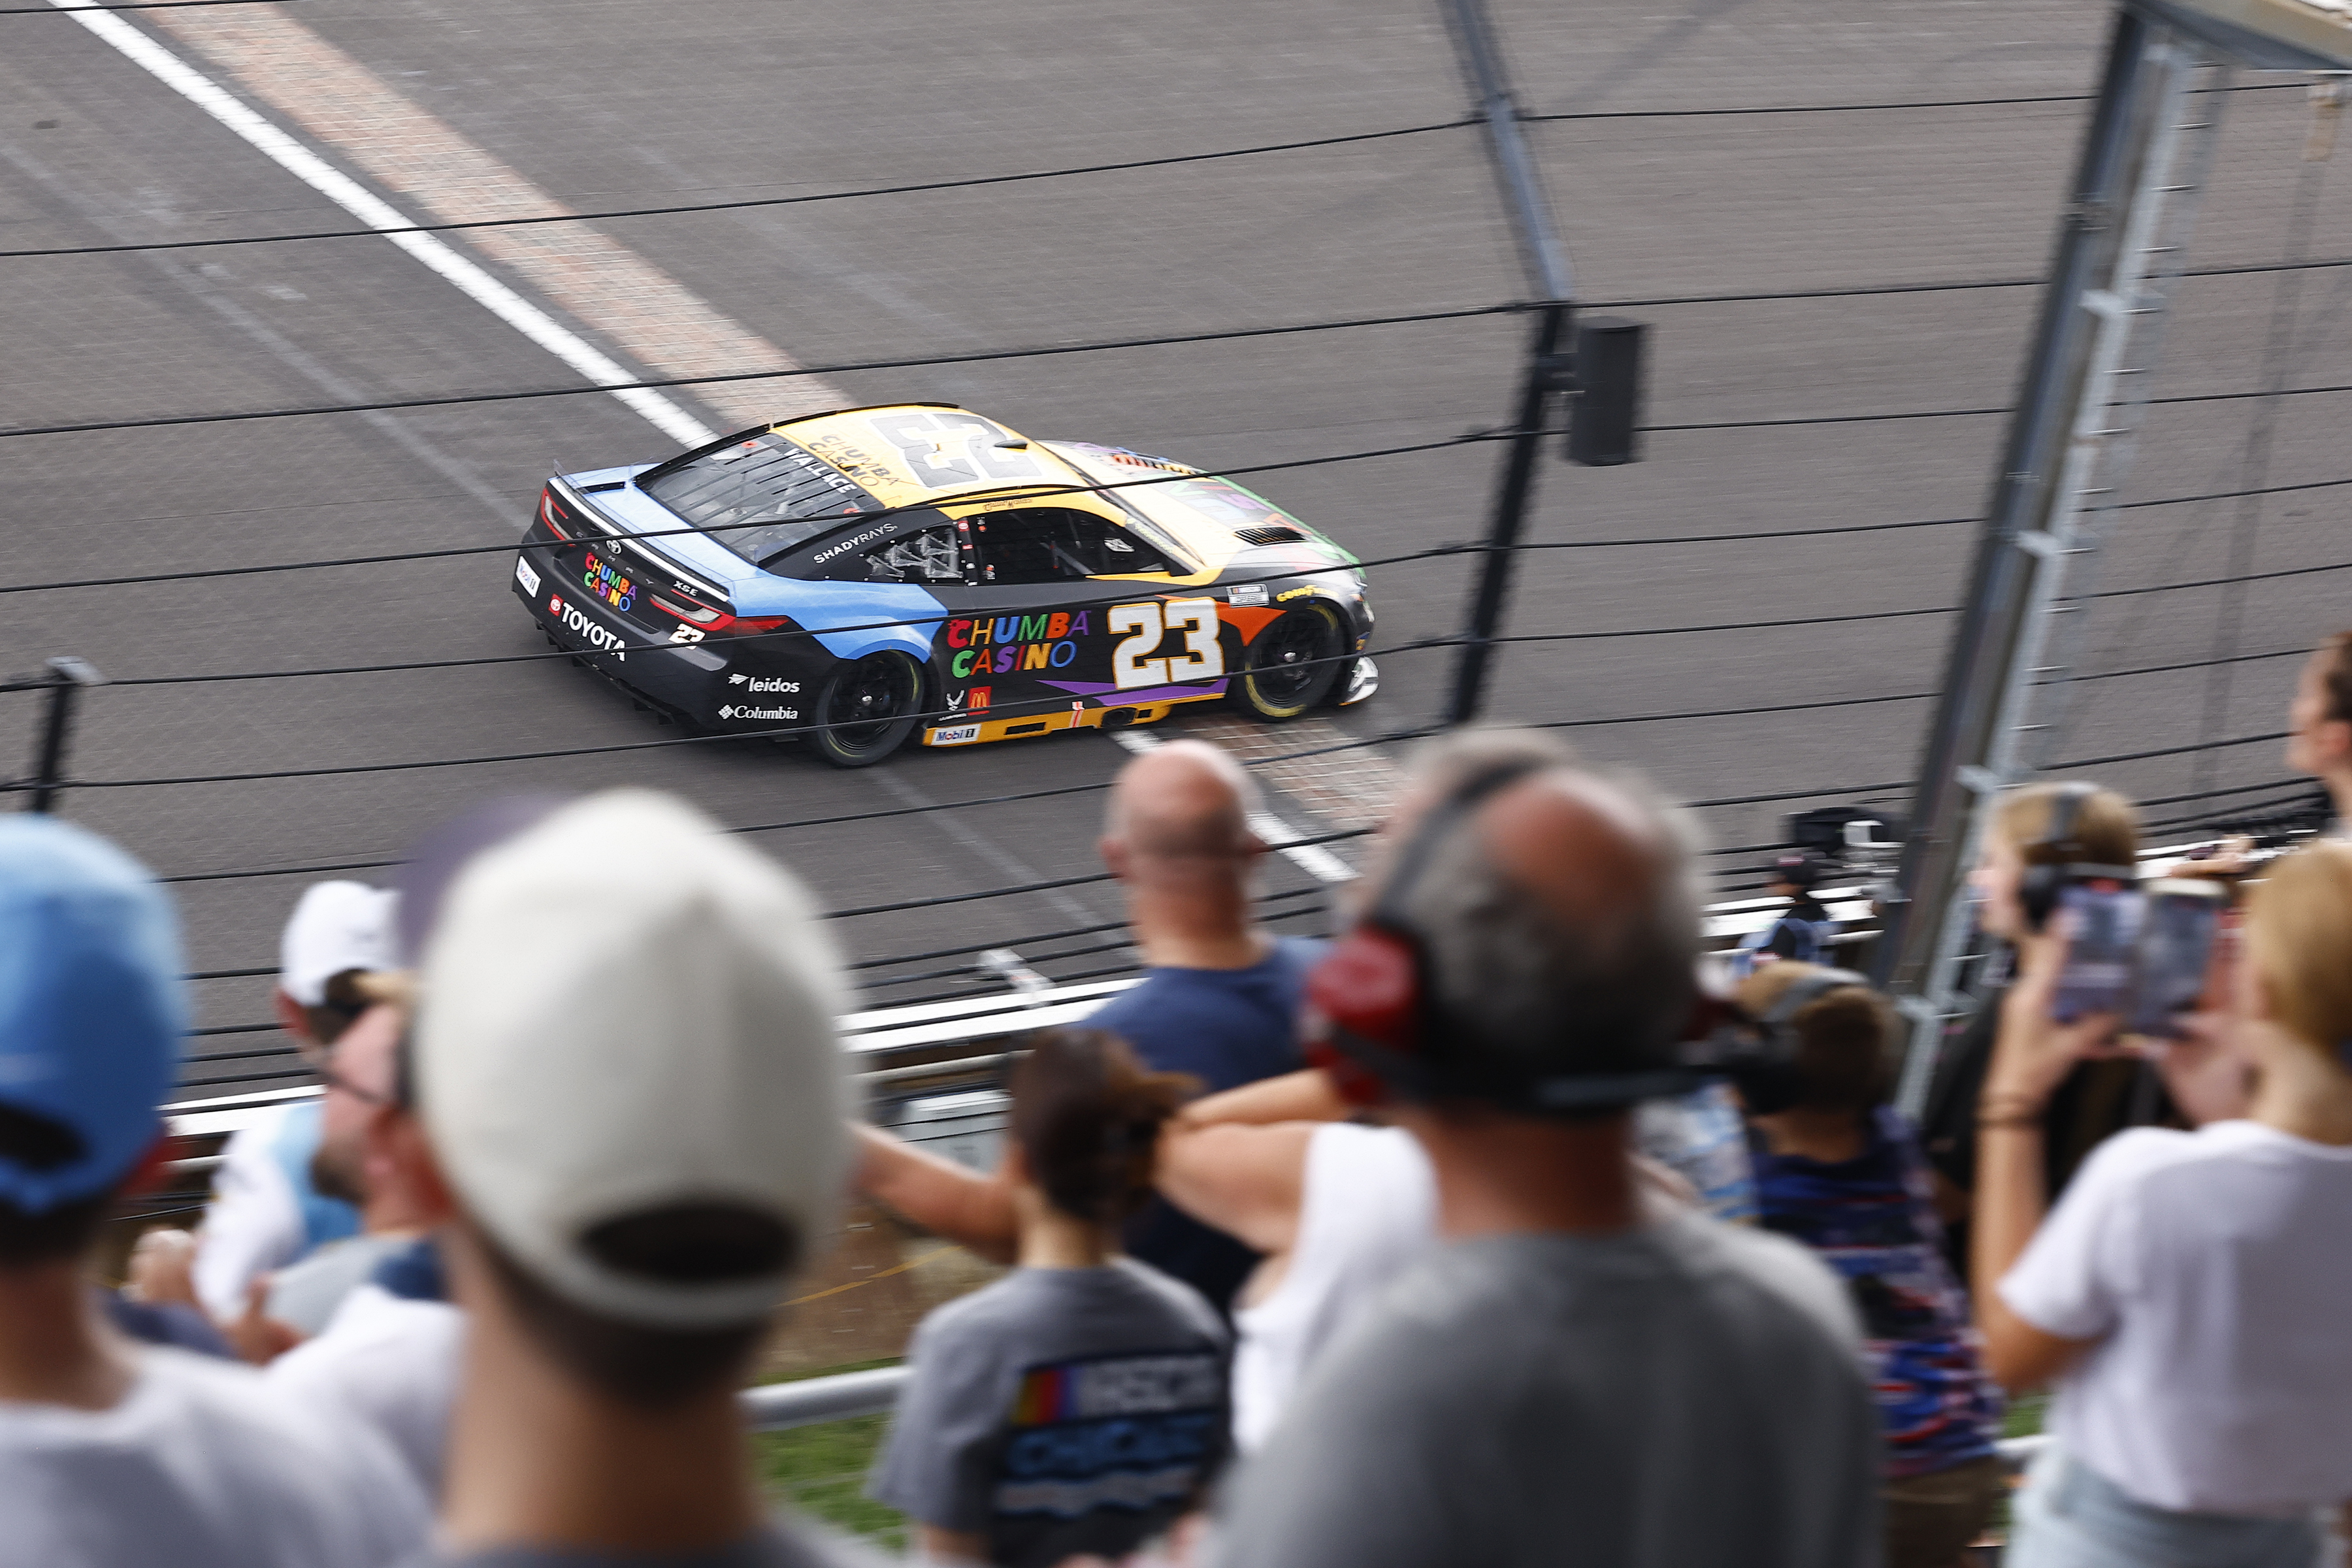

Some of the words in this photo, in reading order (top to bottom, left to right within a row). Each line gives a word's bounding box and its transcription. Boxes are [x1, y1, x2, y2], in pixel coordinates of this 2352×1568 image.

[784, 448, 858, 494] WALLACE
[808, 442, 879, 487] CASINO
[821, 434, 901, 486] CHUMBA
[584, 572, 631, 612] CASINO
[585, 552, 638, 600] CHUMBA
[673, 580, 699, 597] XSE
[562, 602, 625, 662] TOYOTA
[668, 623, 706, 650] 23
[947, 610, 1092, 648] CHUMBA
[1107, 596, 1225, 690] 23
[951, 641, 1077, 678] CASINO
[748, 677, 801, 693] leidos
[734, 705, 798, 719] Columbia
